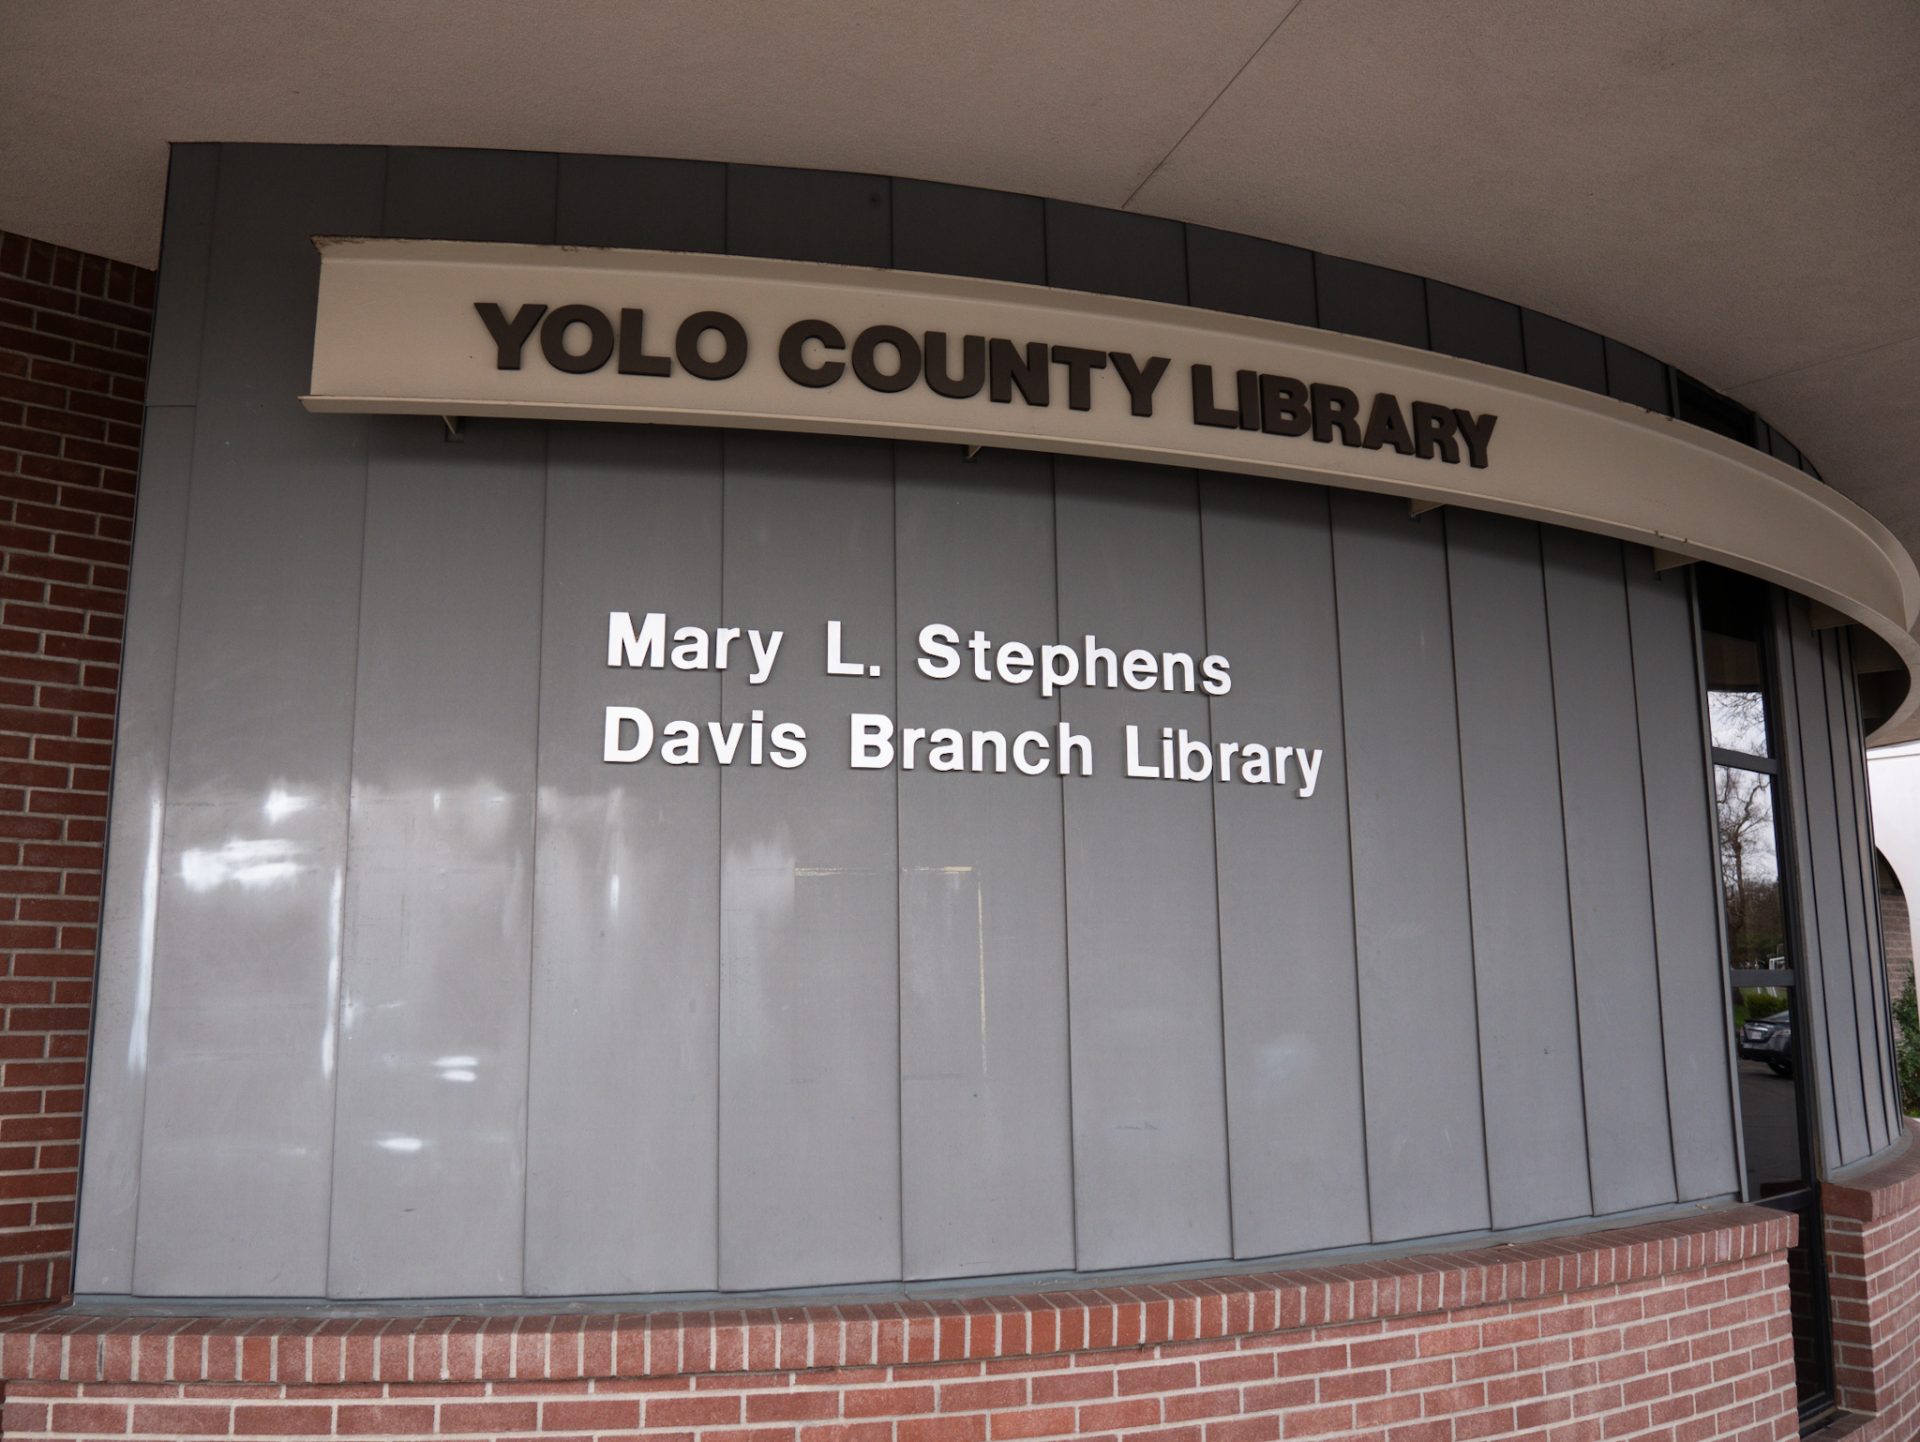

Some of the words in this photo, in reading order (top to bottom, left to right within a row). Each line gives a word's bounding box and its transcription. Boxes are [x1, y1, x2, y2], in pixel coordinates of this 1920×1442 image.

[474, 302, 748, 381] YOLO
[777, 318, 1171, 417] COUNTY
[1191, 364, 1498, 469] LIBRARY
[607, 611, 783, 686] Mary
[827, 621, 881, 678] L.
[917, 624, 1231, 697] Stephens
[603, 705, 808, 769] Davis
[850, 713, 1093, 778] Branch
[1125, 725, 1323, 799] Library
